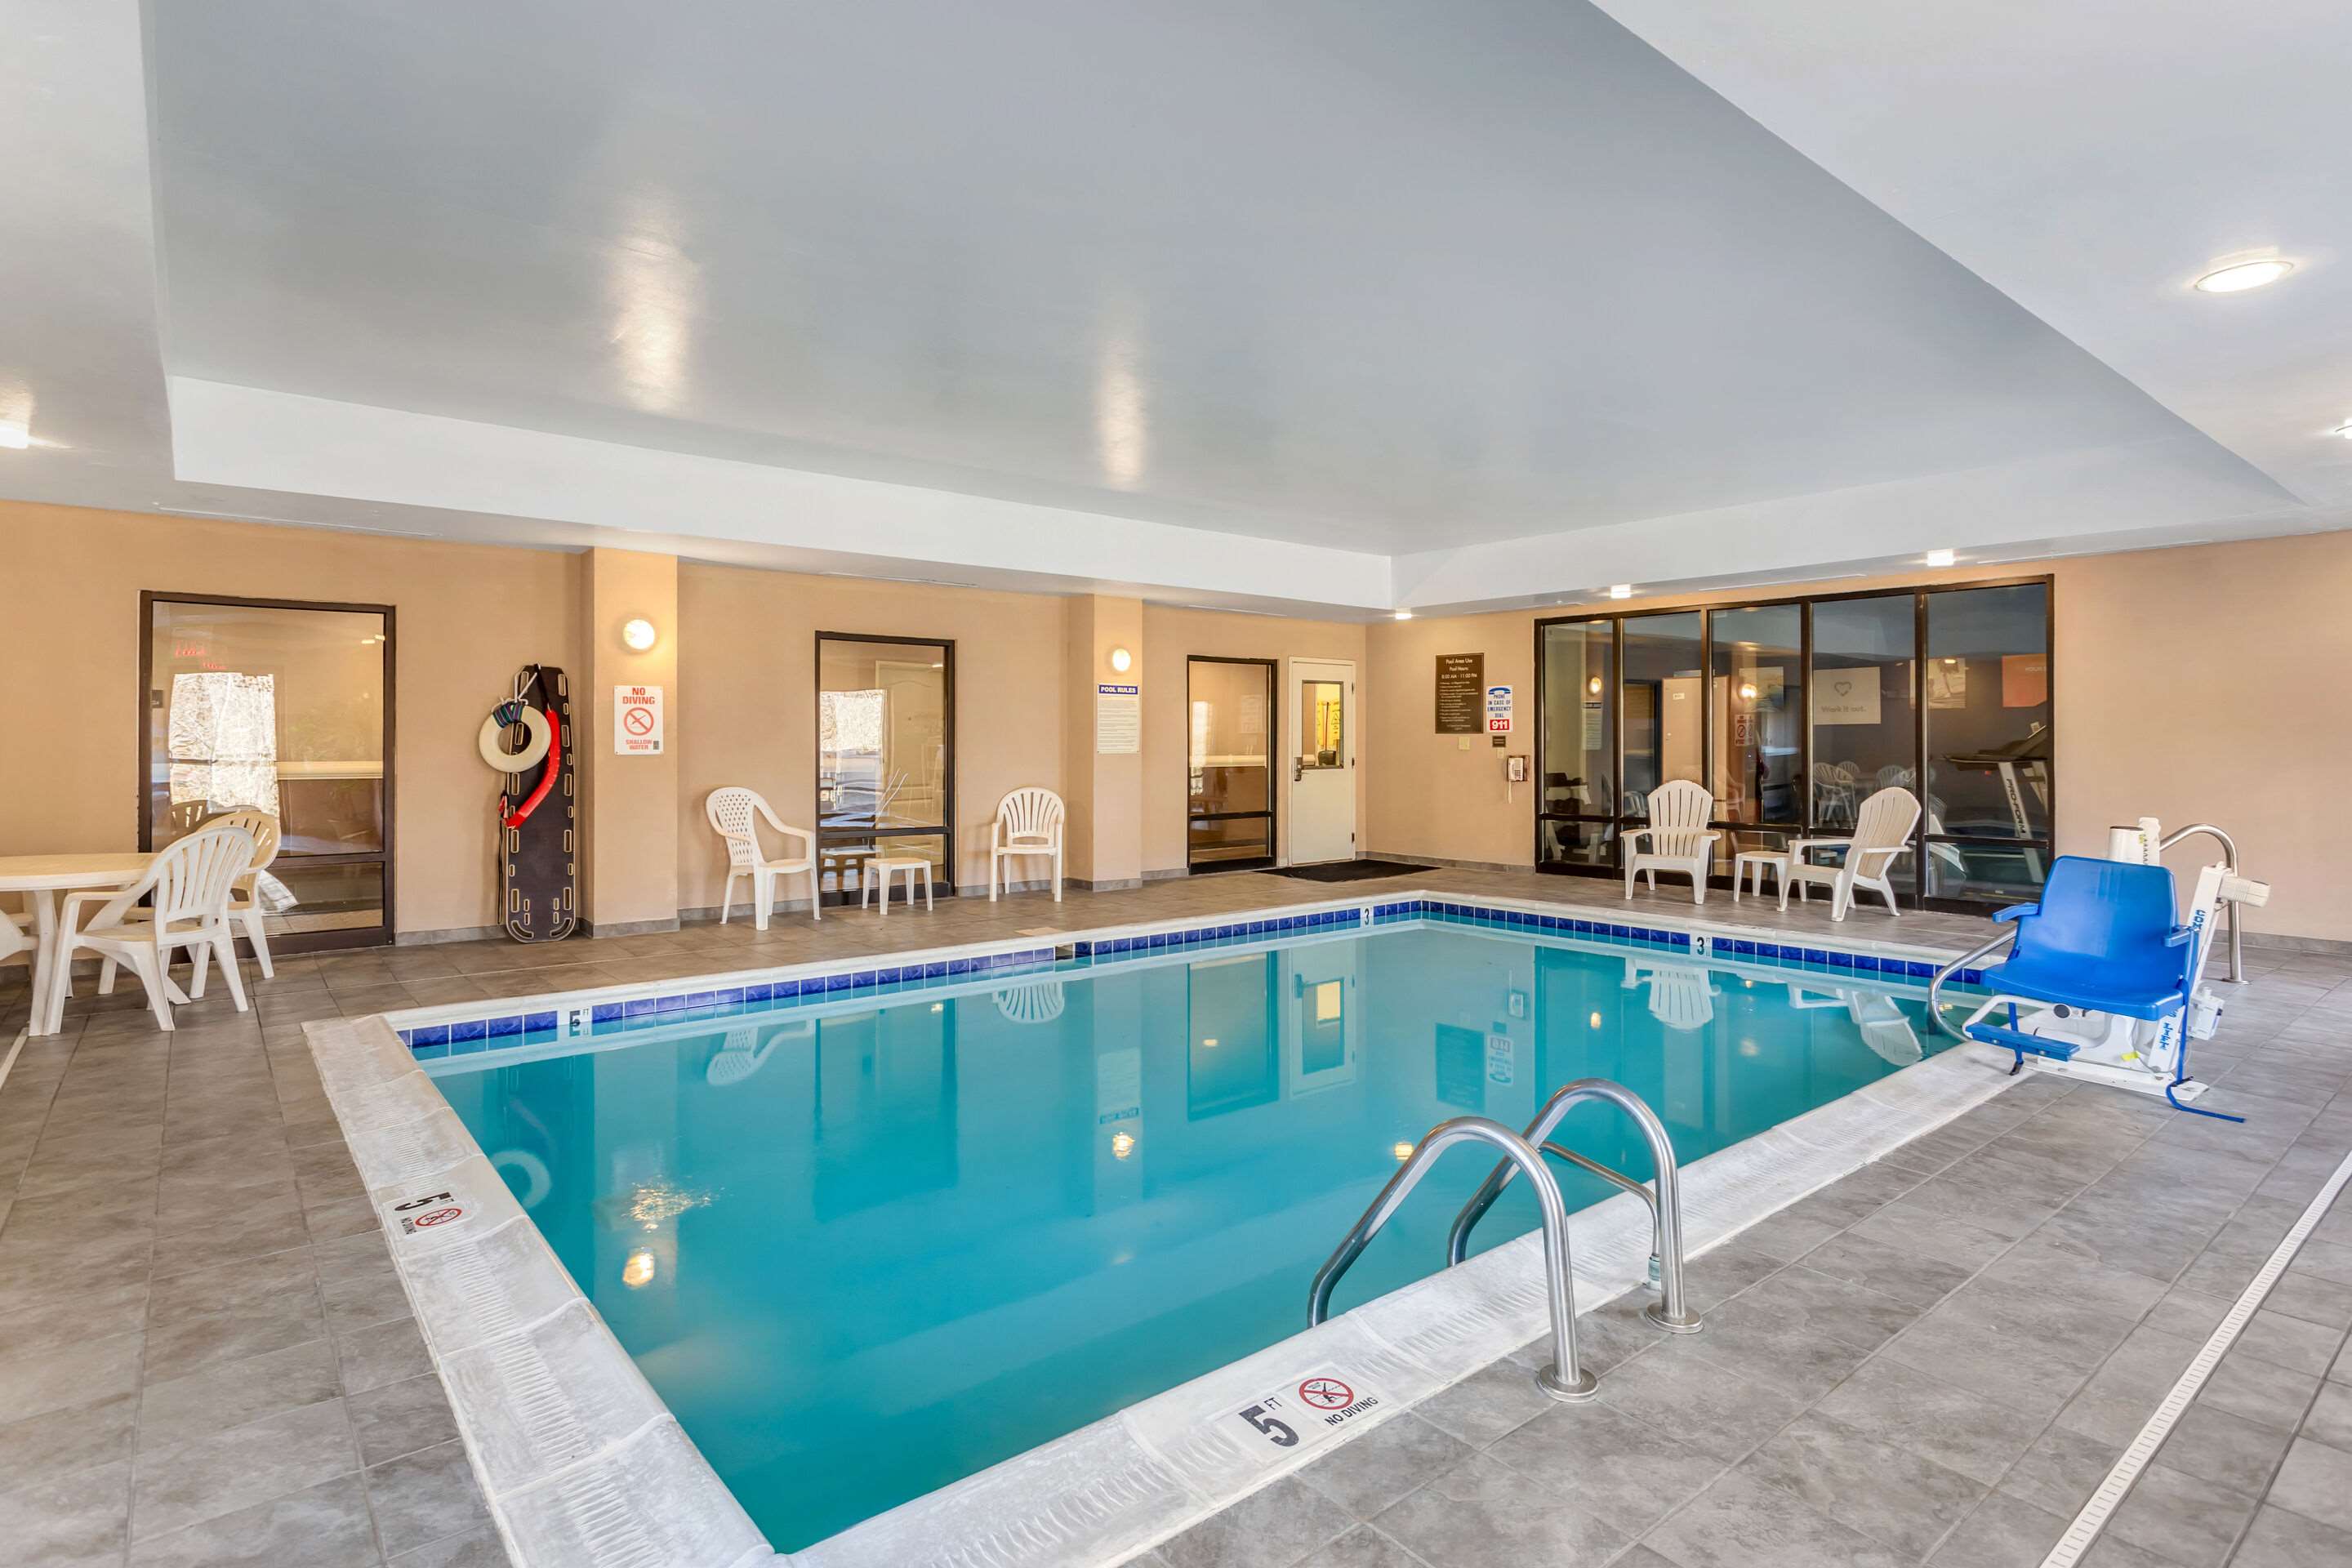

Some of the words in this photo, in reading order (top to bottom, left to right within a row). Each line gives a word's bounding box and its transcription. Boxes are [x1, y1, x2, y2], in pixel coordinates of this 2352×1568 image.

[632, 687, 645, 695] NO
[622, 696, 655, 704] DIVING
[1491, 720, 1508, 729] 911
[394, 1192, 452, 1211] 5
[1263, 1396, 1283, 1410] FT
[1325, 1414, 1343, 1426] NO
[1341, 1396, 1379, 1418] DIVING
[1238, 1404, 1299, 1447] 5
